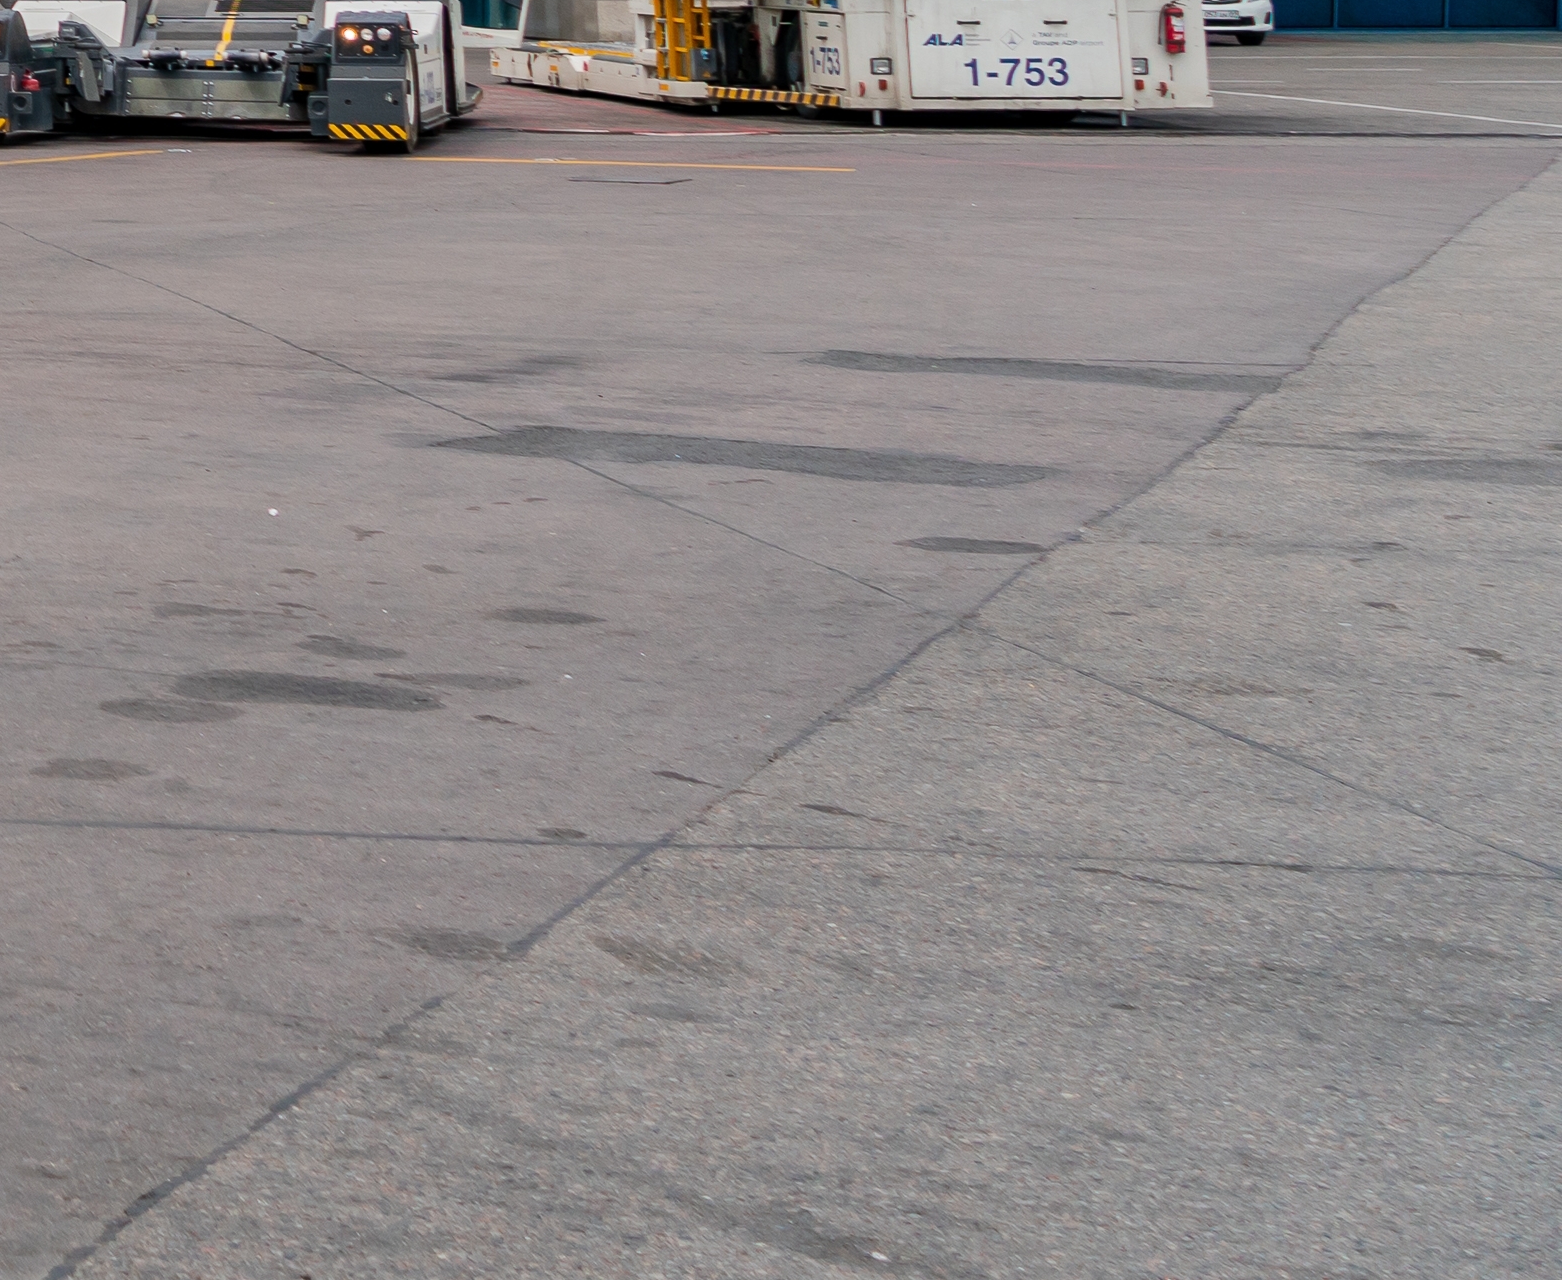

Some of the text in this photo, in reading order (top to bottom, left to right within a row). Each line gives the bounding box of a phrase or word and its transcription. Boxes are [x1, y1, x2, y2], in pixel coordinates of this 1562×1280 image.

[923, 33, 964, 46] ALA
[810, 46, 841, 77] 1-753
[964, 57, 1069, 87] 1-753
